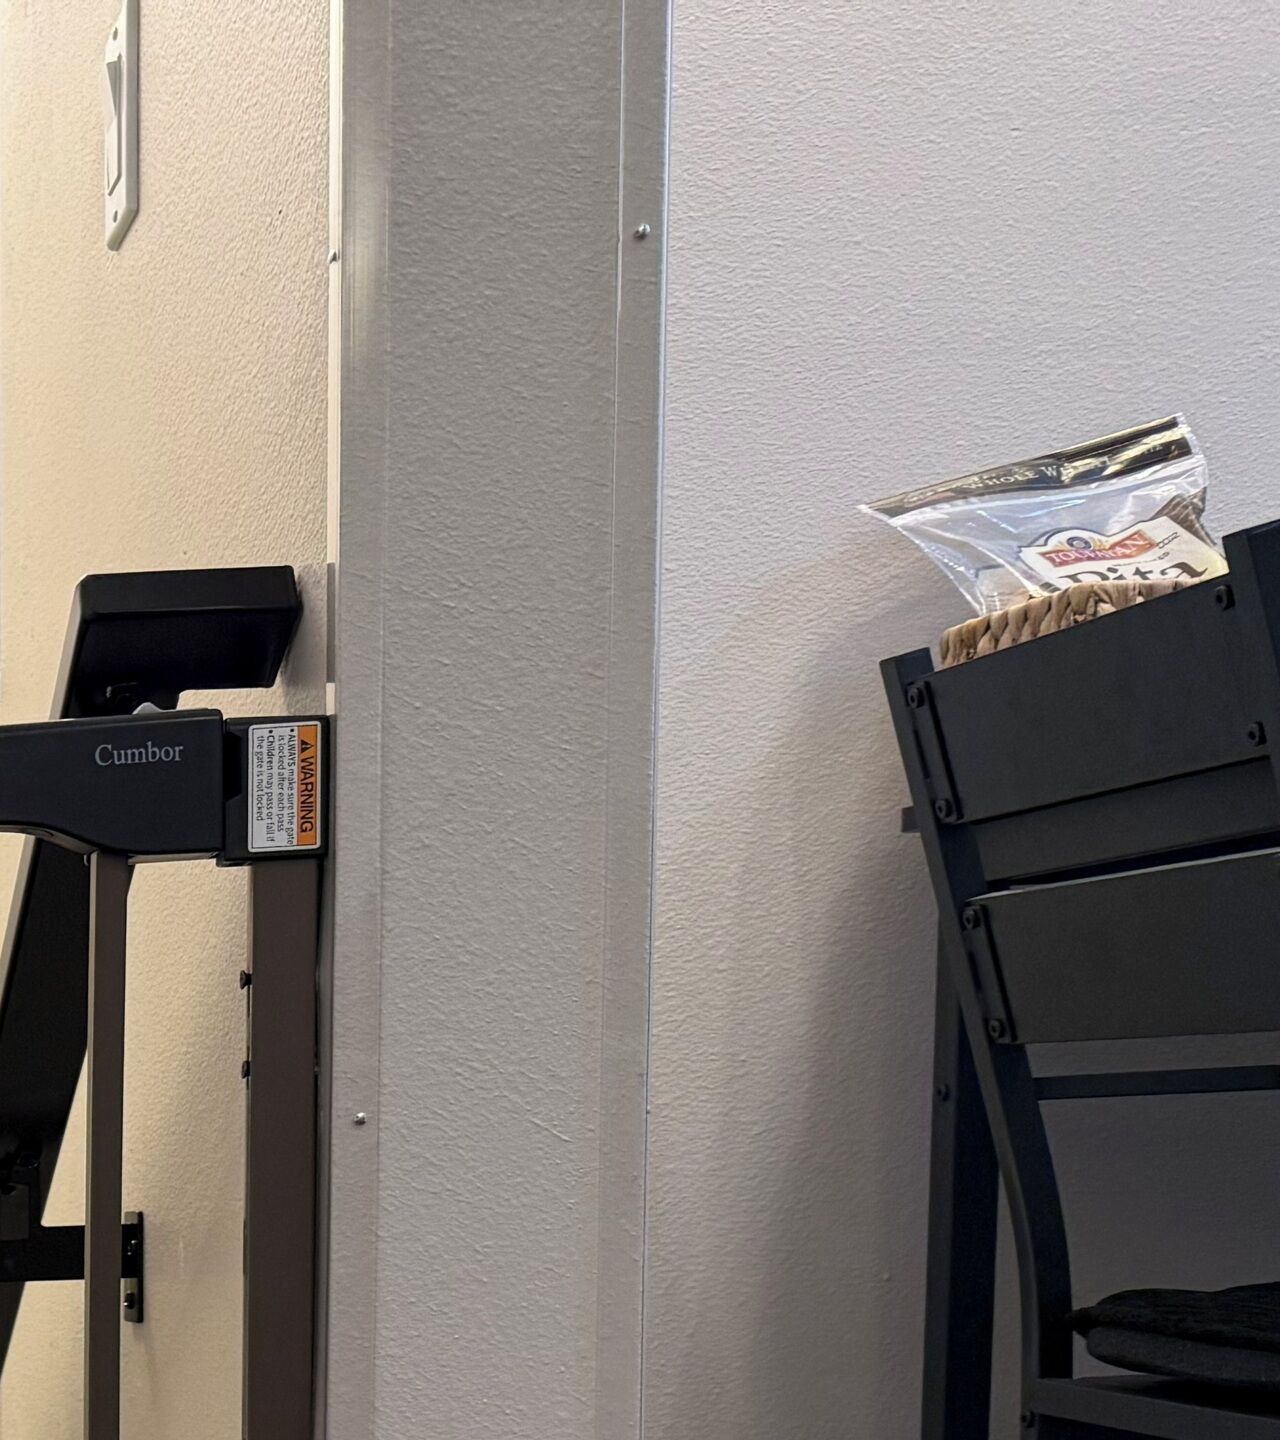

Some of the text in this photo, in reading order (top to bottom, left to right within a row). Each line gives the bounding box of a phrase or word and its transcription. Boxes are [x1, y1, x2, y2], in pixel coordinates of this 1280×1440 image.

[964, 467, 1039, 489] WHOLE
[95, 741, 183, 766] Cumbor
[255, 751, 263, 768] gate
[266, 735, 275, 771] Children
[277, 742, 285, 771] locked
[288, 734, 296, 767] ALWAYS
[256, 778, 264, 795] not
[265, 772, 273, 790] may
[277, 771, 285, 791] after
[265, 791, 273, 810] pass
[277, 792, 285, 812] each
[300, 756, 314, 832] WARNING
[256, 795, 264, 821] locked
[266, 811, 273, 820] or
[266, 821, 275, 835] fall
[276, 813, 284, 832] pass
[285, 826, 294, 845] gate
